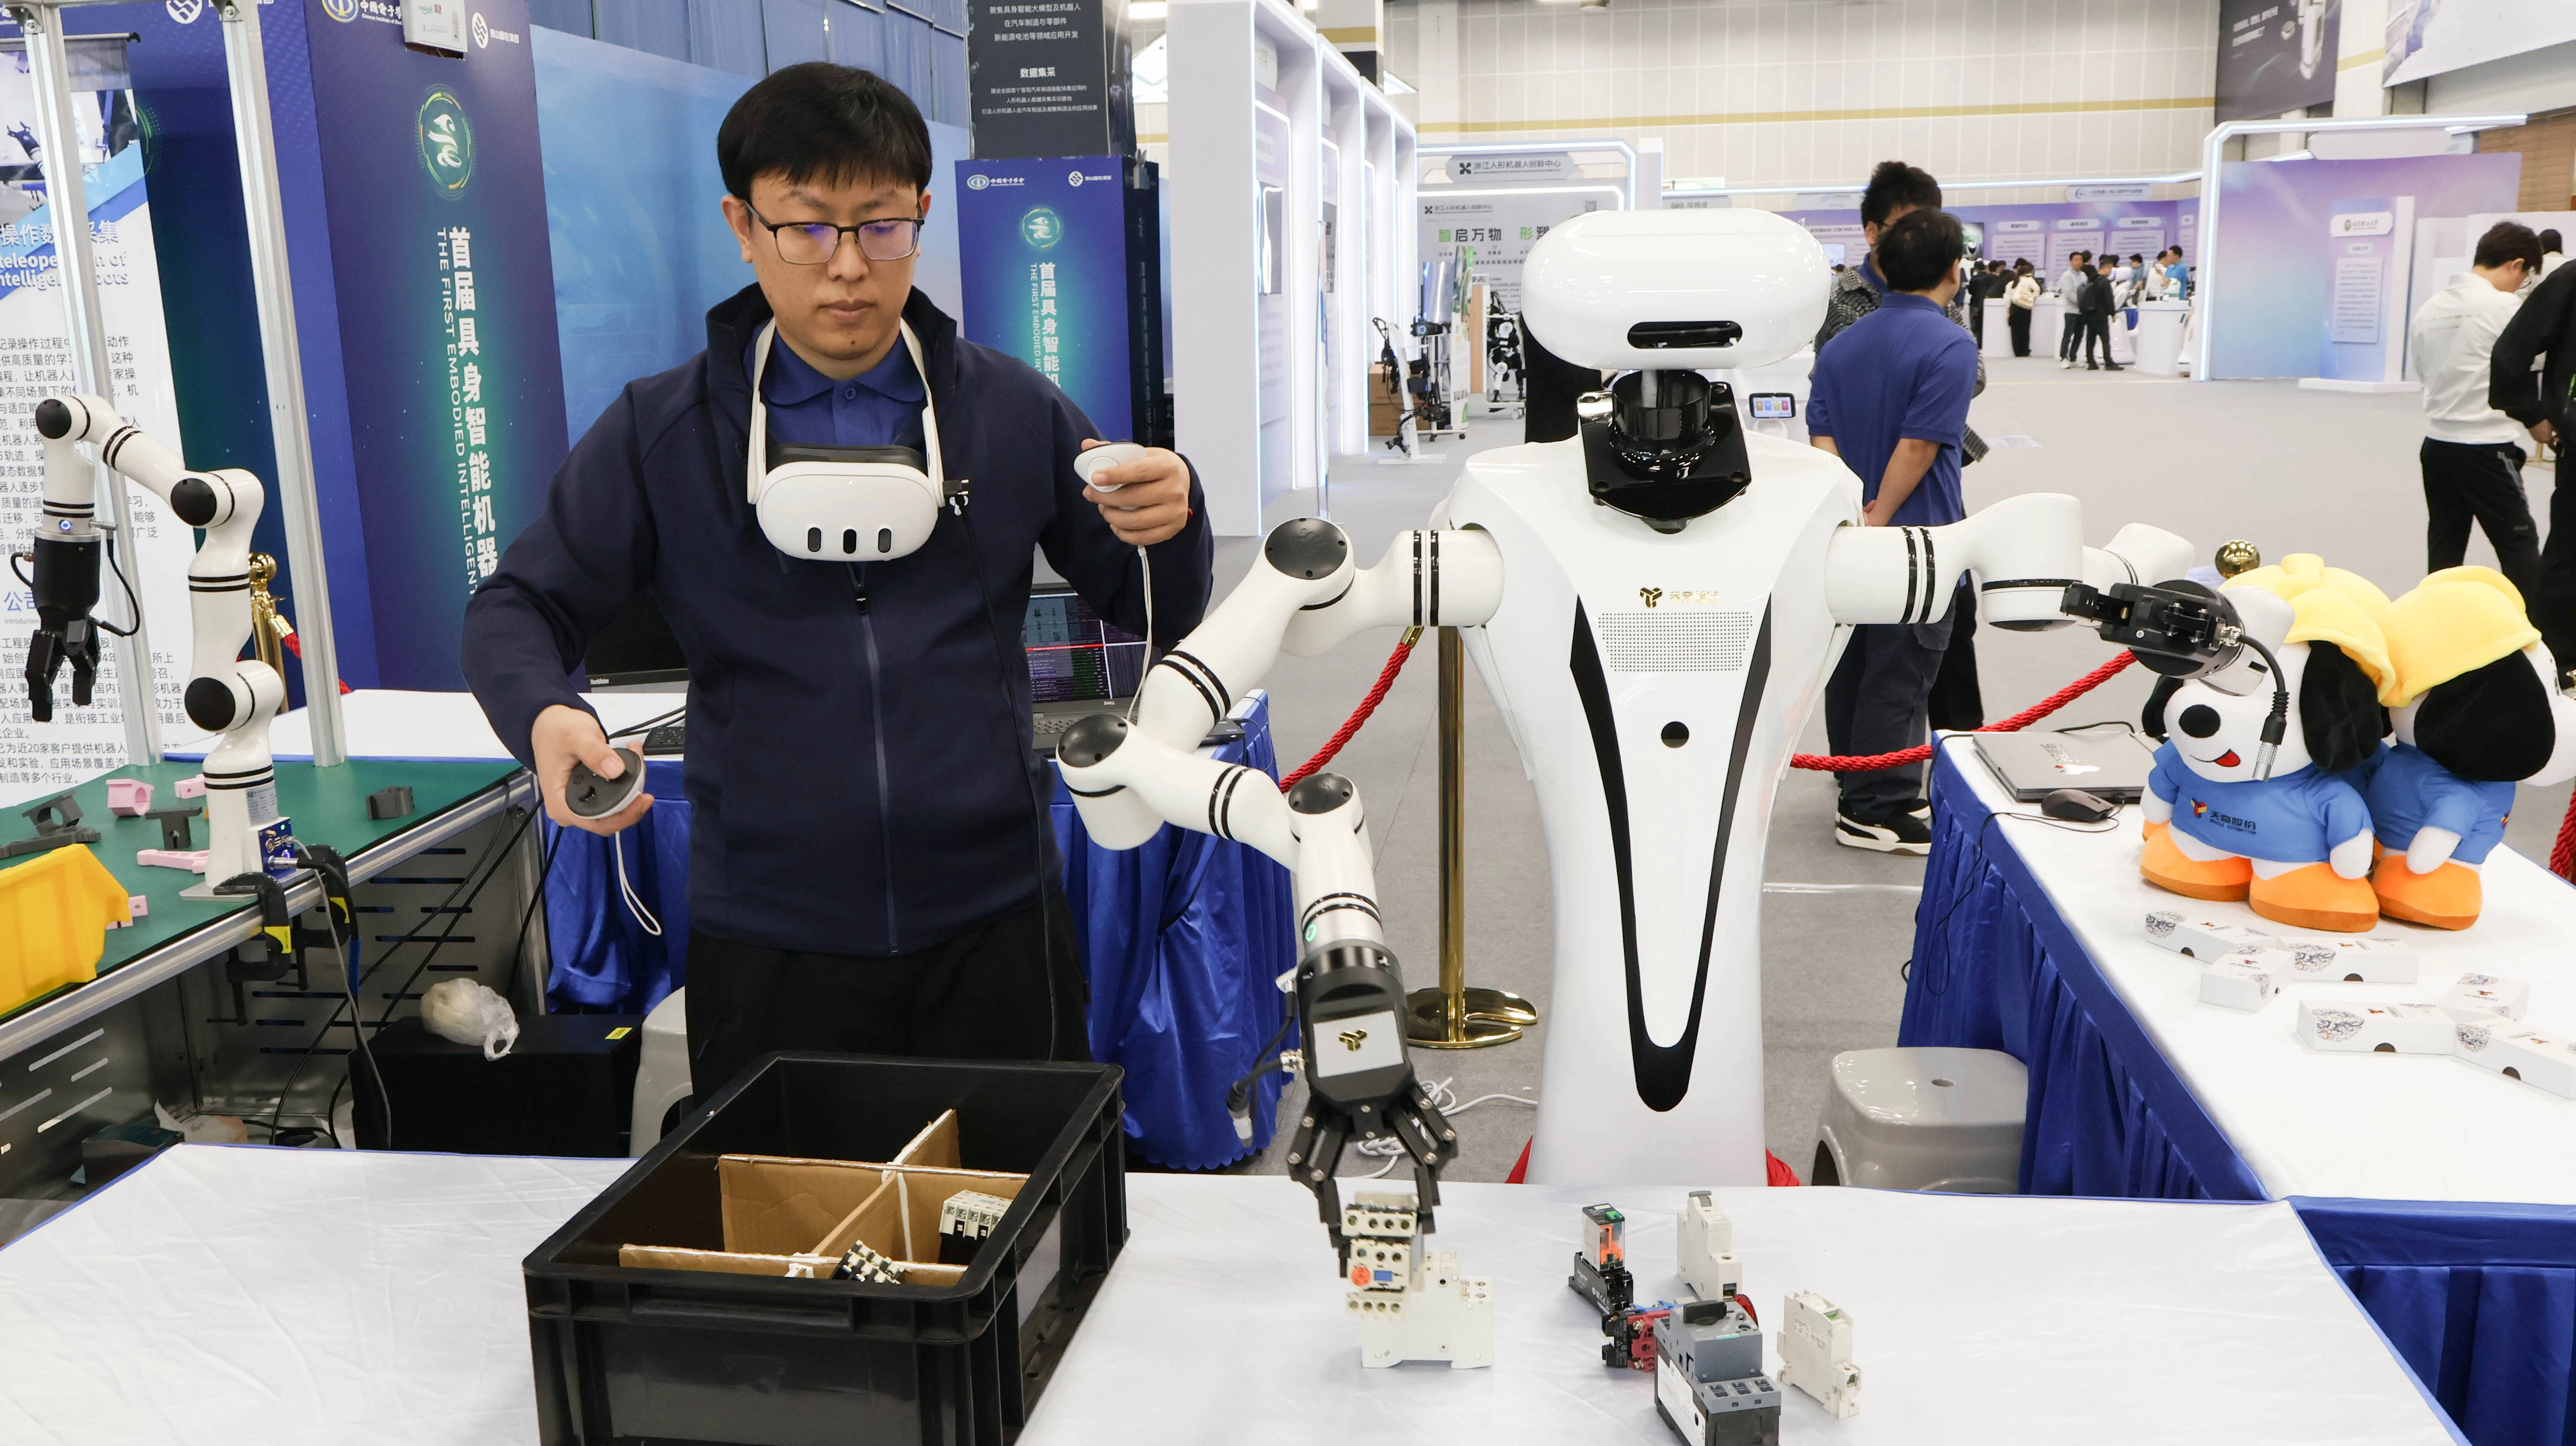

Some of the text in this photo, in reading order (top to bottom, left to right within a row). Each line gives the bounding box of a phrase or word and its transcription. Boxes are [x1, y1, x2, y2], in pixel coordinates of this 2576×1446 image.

[1020, 67, 1055, 78] 数据集采
[437, 227, 450, 271] THE
[1439, 228, 1502, 242] 智启万物
[441, 278, 456, 337] FIRST
[1032, 310, 1041, 356] EMBODIED
[447, 343, 465, 456] EMBODIED
[449, 226, 498, 578] 首届具身智能机器
